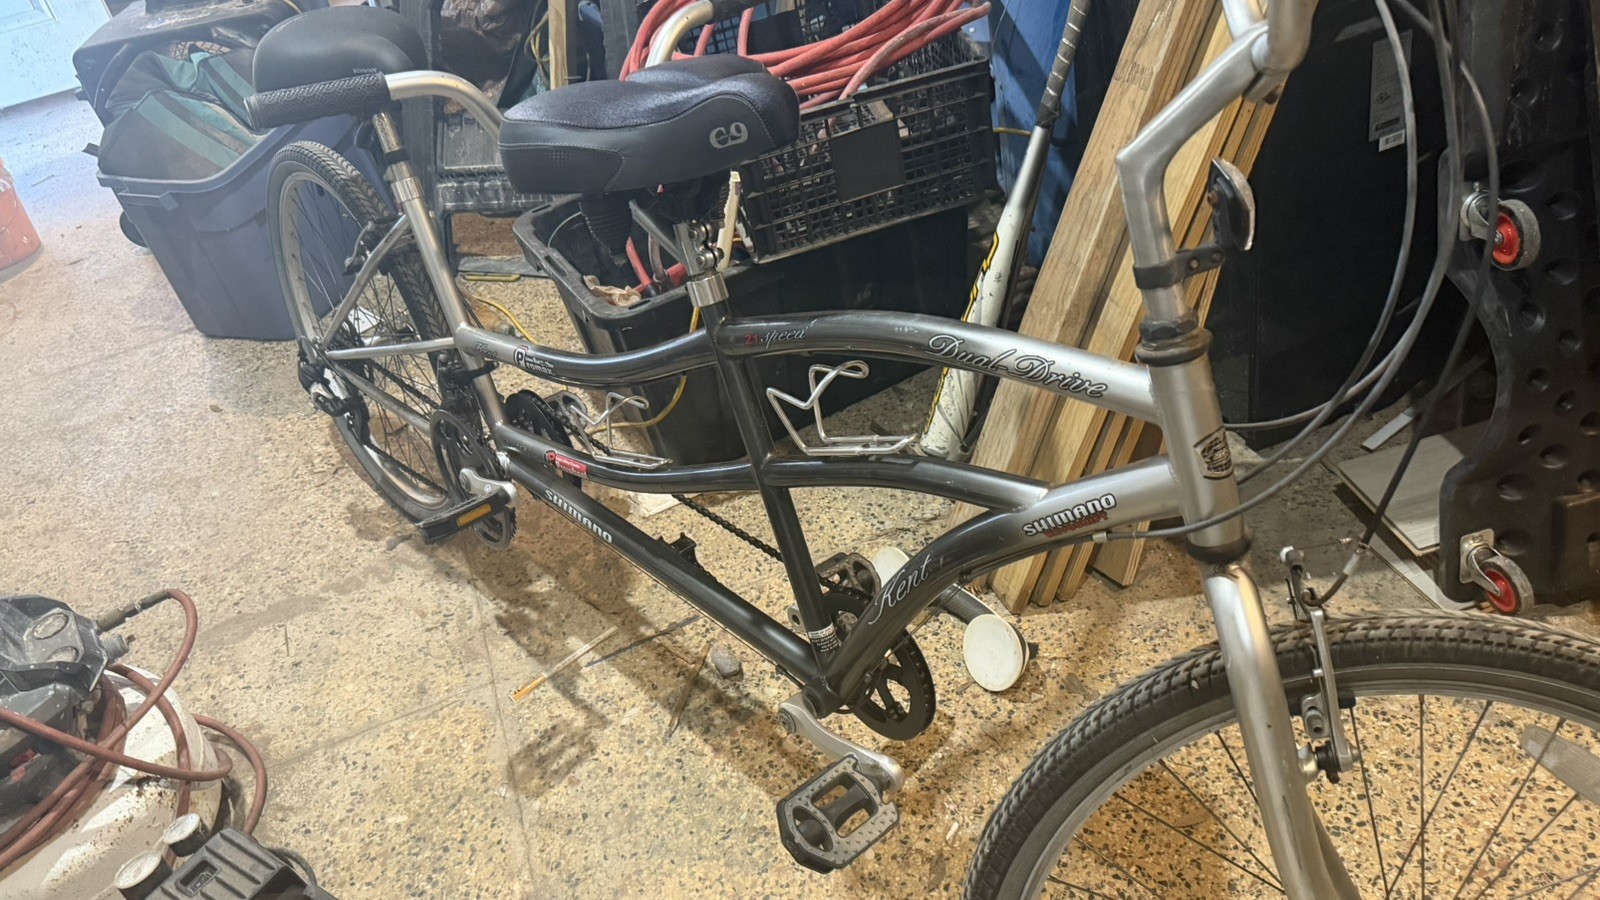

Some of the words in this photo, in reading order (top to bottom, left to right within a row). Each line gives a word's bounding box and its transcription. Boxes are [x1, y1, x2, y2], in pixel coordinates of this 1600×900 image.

[744, 332, 759, 345] 21
[760, 318, 818, 350] speed
[544, 488, 614, 544] SHIMANO
[1022, 492, 1117, 537] SHIMANO
[867, 553, 932, 625] Kent
